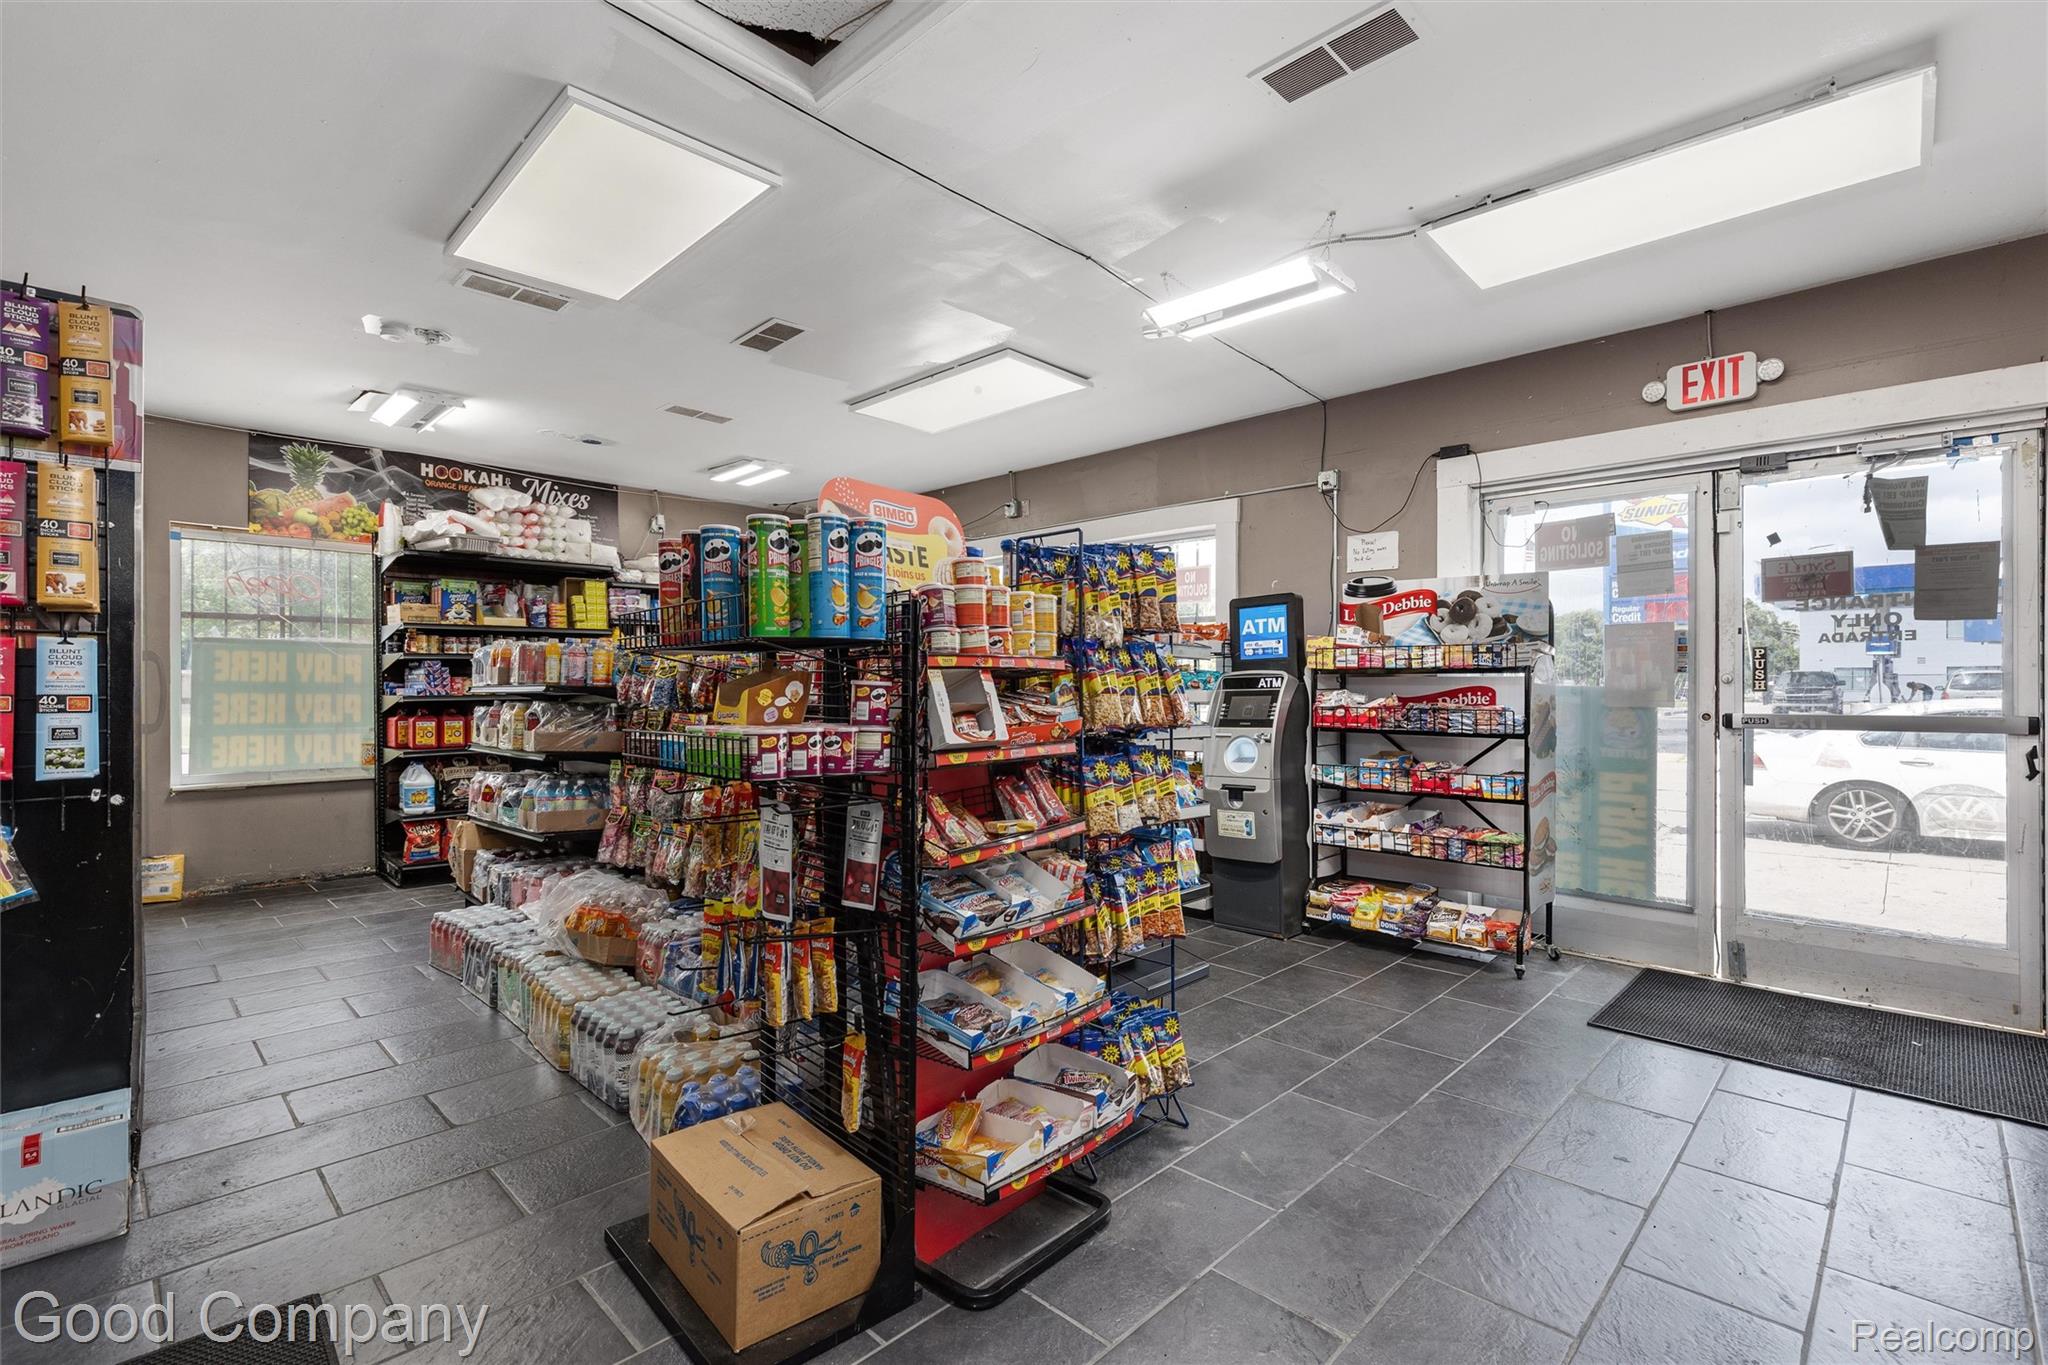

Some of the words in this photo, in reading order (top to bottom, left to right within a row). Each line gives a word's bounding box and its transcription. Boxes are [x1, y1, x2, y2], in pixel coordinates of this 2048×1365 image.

[4, 306, 39, 318] CLOUD
[5, 301, 38, 312] BLUNT
[3, 312, 39, 324] STICKS
[69, 313, 98, 321] BLUNT
[68, 324, 100, 332] STICKS
[69, 319, 100, 327] CLOUD
[63, 359, 78, 368] 40
[1682, 355, 1744, 405] EXIT
[50, 479, 83, 487] CLOUD
[420, 463, 503, 487] HOOKAH
[522, 478, 590, 510] Mixes
[425, 480, 456, 490] ORANGE
[49, 485, 83, 494] STICKS
[874, 504, 914, 523] BIMBO
[1626, 502, 1688, 520] SUNOCO
[40, 520, 58, 530] 40
[704, 561, 731, 575] PRINGLES
[856, 555, 882, 570] PRINGLES
[893, 567, 914, 580] joins
[915, 572, 926, 581] us
[1486, 579, 1511, 589] Unwrap
[1519, 578, 1537, 586] Smile
[1383, 597, 1432, 616] Debbie
[1612, 605, 1640, 613] Regular
[1612, 611, 1641, 622] Credit
[1242, 617, 1285, 634] ATM
[1754, 648, 1766, 690] PUSH
[1258, 677, 1282, 688] ATM
[39, 695, 57, 706] 40
[1742, 717, 1768, 725] PUSH
[1332, 913, 1351, 921] DONU
[57, 1194, 103, 1210] GLACIAL
[850, 1208, 860, 1217] UP
[19, 1229, 48, 1240] SPRING
[50, 1221, 76, 1232] WATER
[25, 1232, 60, 1245] ICELAND
